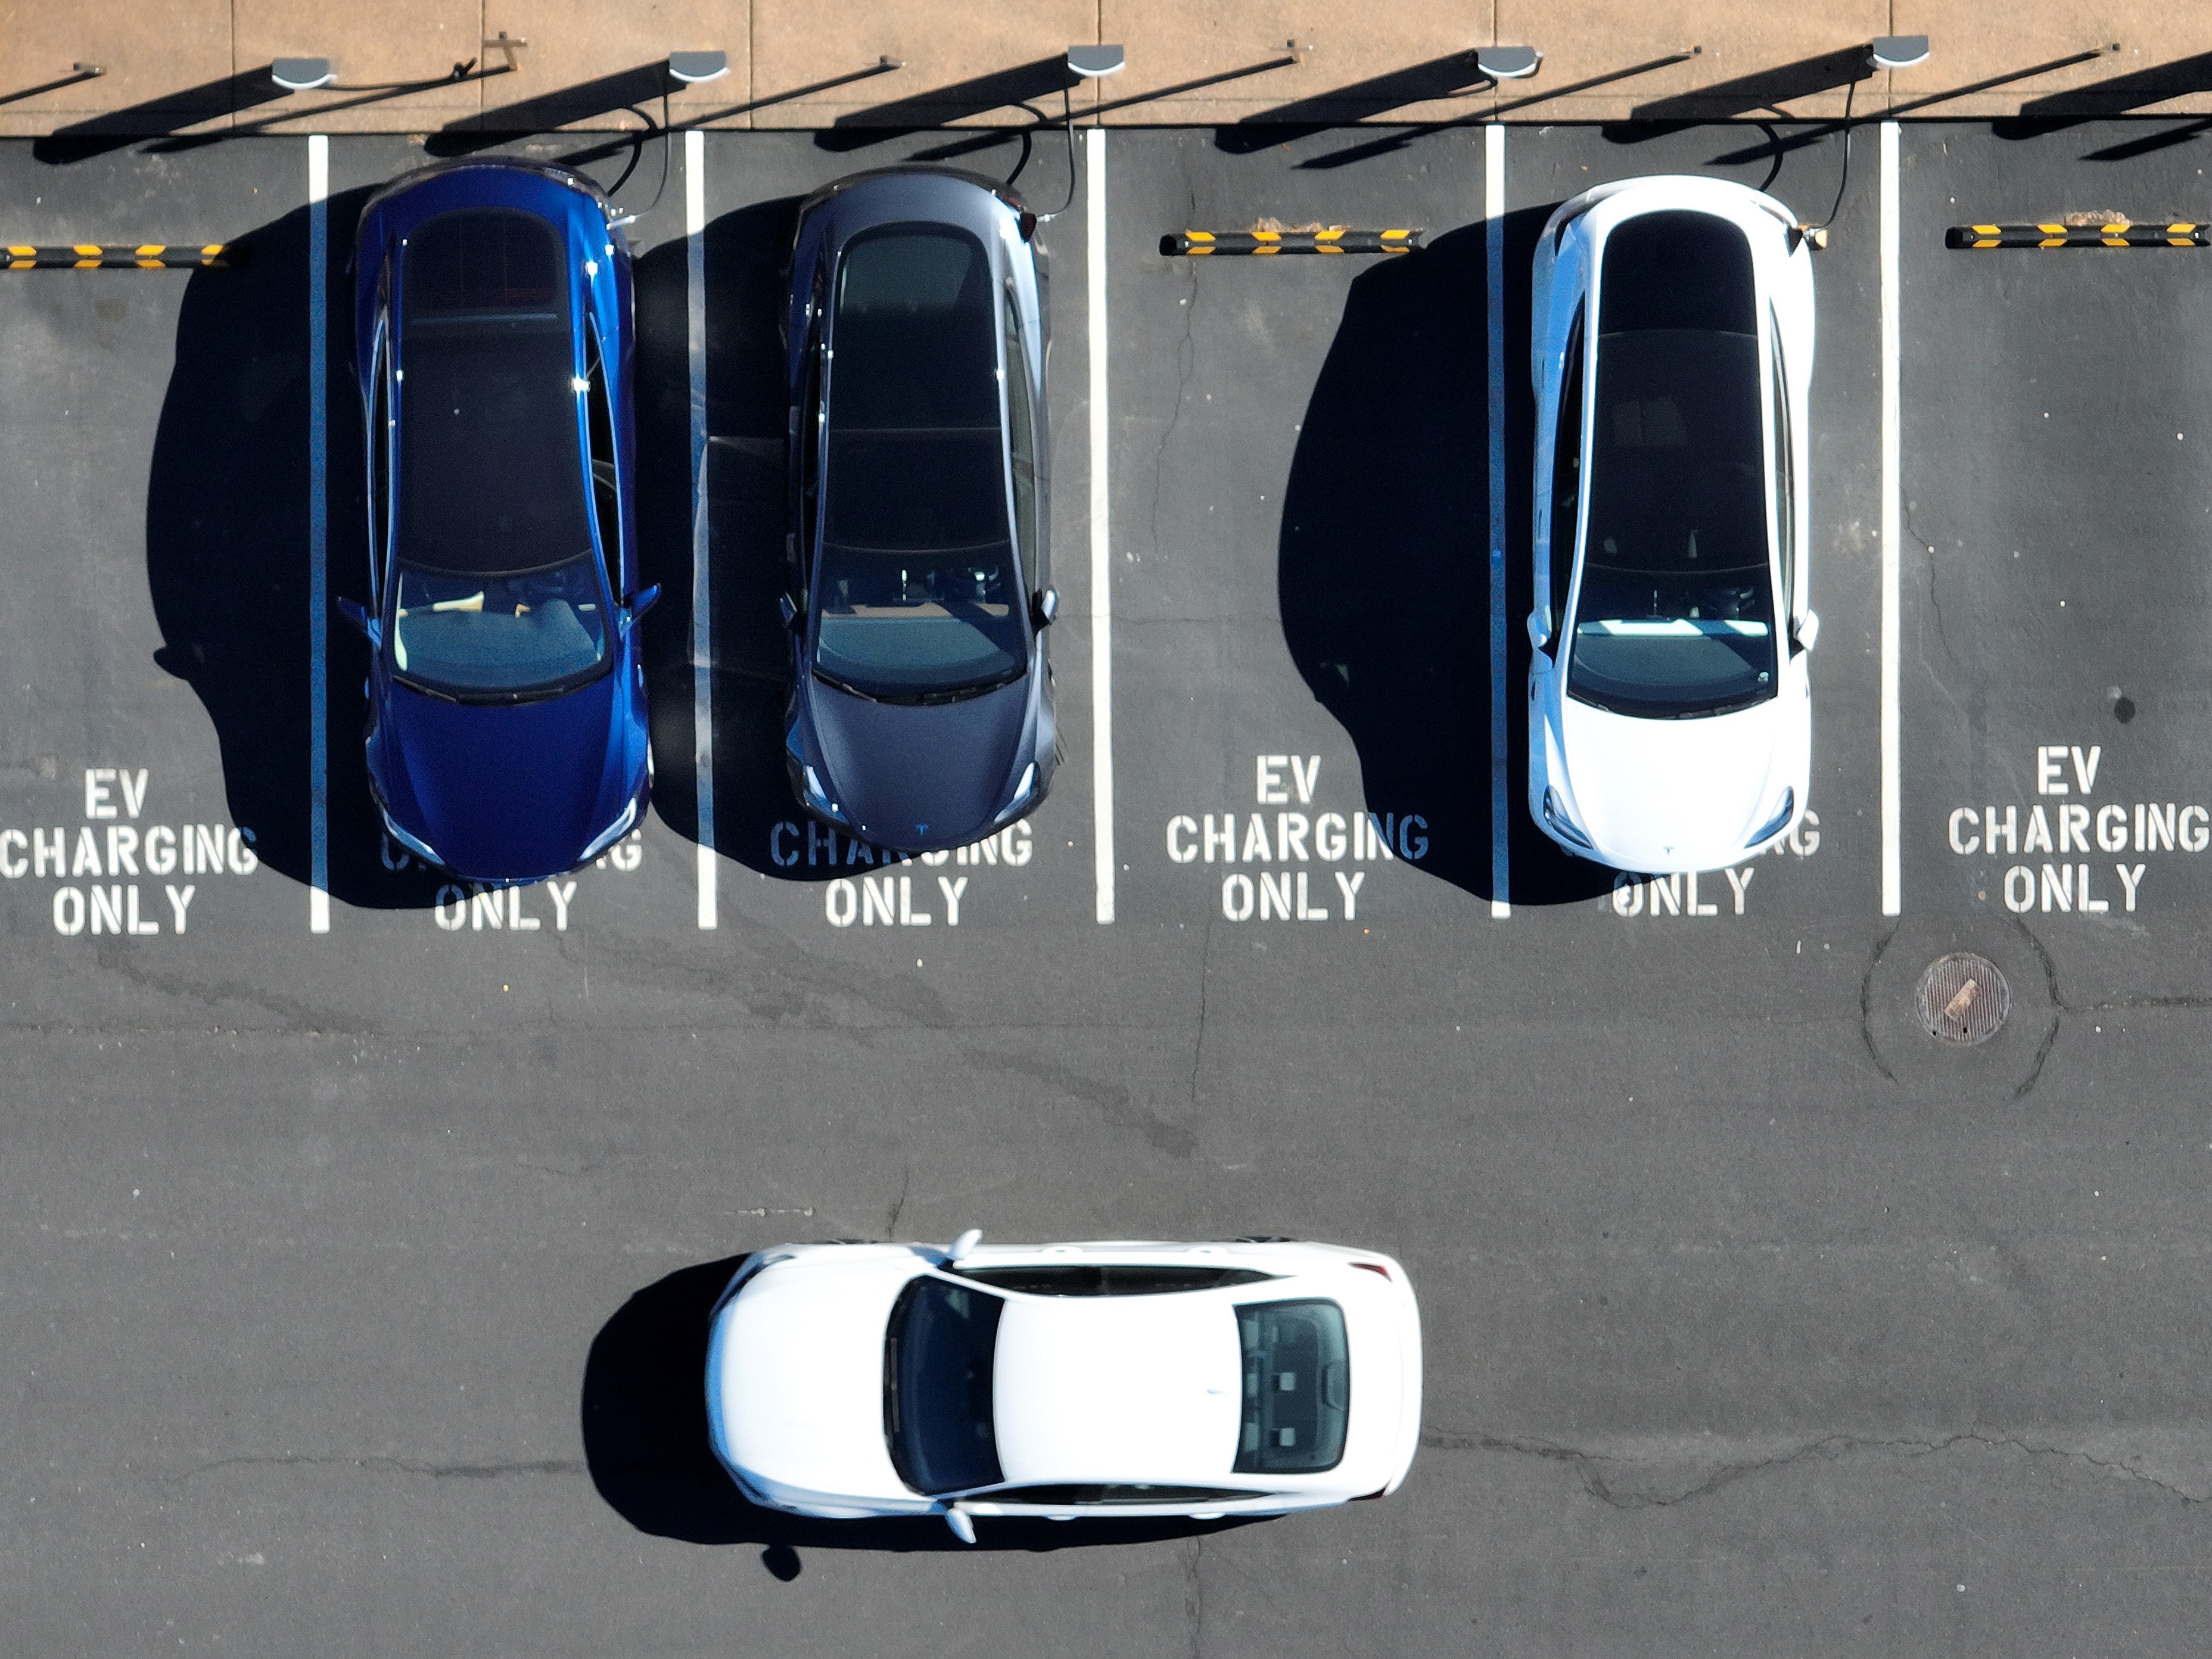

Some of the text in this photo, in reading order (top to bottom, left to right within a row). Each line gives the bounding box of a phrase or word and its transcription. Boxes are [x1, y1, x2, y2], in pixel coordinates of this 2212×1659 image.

[85, 768, 150, 820] EV
[1256, 755, 1321, 805] EV
[2037, 746, 2101, 795] EV
[0, 824, 258, 879] CHARGING
[1166, 812, 1429, 861] CHARGING
[1949, 803, 2210, 854] CHARGING
[52, 884, 195, 936] ONLY
[434, 880, 577, 932] ONLY
[825, 876, 968, 927] ONLY
[1222, 871, 1365, 922] ONLY
[1611, 867, 1755, 917] ONLY
[2004, 863, 2146, 914] ONLY
